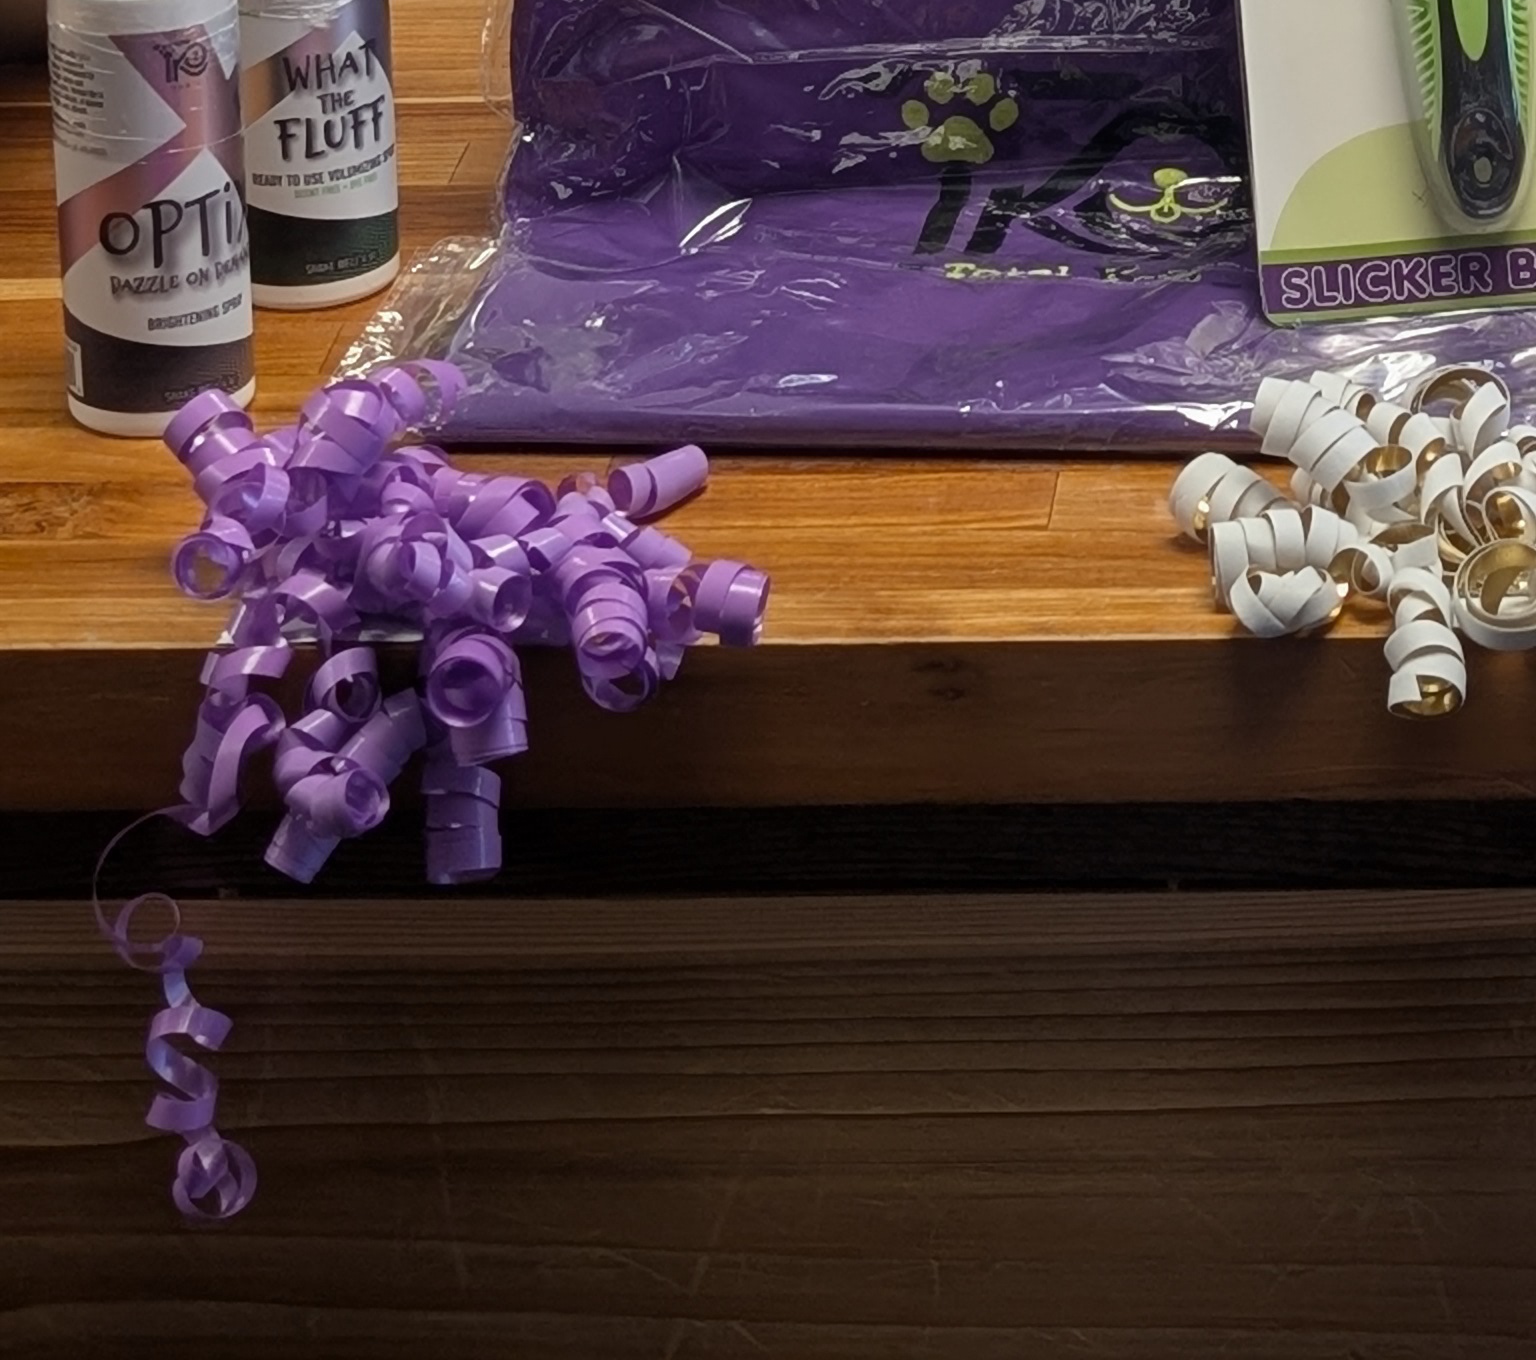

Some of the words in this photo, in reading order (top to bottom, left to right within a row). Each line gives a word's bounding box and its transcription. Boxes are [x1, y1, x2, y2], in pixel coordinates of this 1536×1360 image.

[282, 37, 376, 91] WHAT
[316, 89, 355, 115] THE
[273, 94, 385, 161] FLUFF
[252, 173, 283, 187] READY
[286, 174, 300, 187] TO
[303, 172, 324, 186] USE
[110, 274, 178, 296] DAZZLE
[185, 268, 209, 286] ON
[1281, 252, 1493, 310] SLICKER
